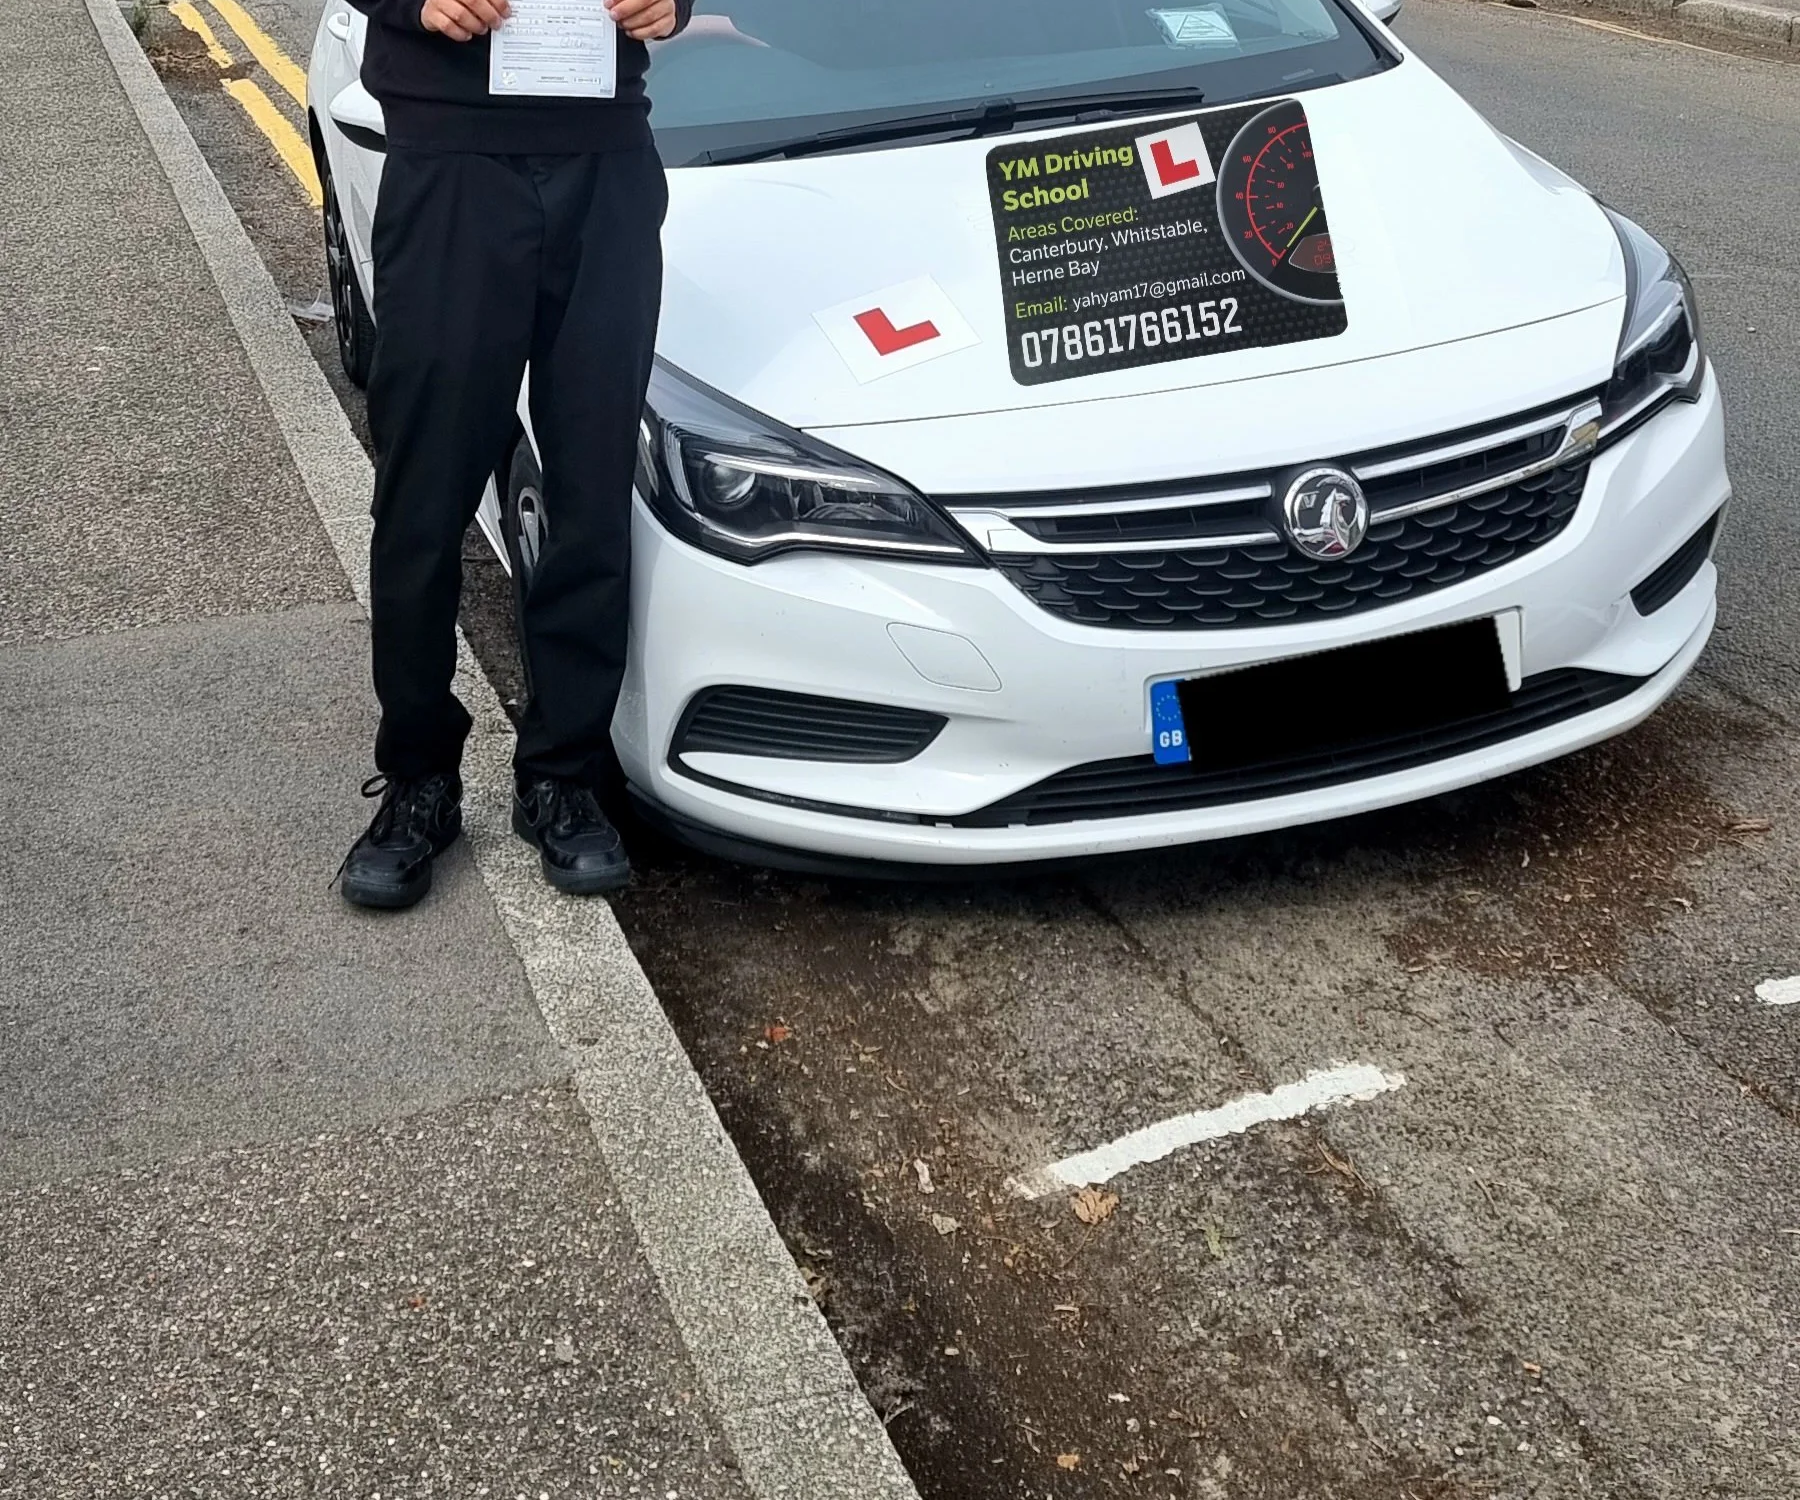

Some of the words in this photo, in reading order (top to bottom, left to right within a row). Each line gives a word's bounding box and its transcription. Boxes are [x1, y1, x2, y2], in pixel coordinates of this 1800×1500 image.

[999, 160, 1039, 182] YM
[1044, 144, 1134, 175] Driving
[1149, 139, 1200, 187] L
[1002, 178, 1090, 212] School
[1007, 221, 1057, 243] Areas
[1060, 206, 1139, 233] Covered:
[1009, 232, 1109, 264] Canterbury,
[1112, 218, 1208, 248] Whitstable,
[1012, 264, 1065, 287] Herne
[1067, 260, 1101, 283] Bay
[1014, 296, 1069, 319] Email:
[1071, 268, 1246, 313] yahyam17@gmail.com
[853, 307, 941, 357] L
[1021, 297, 1243, 368] 07861766152
[1159, 729, 1183, 748] GB
